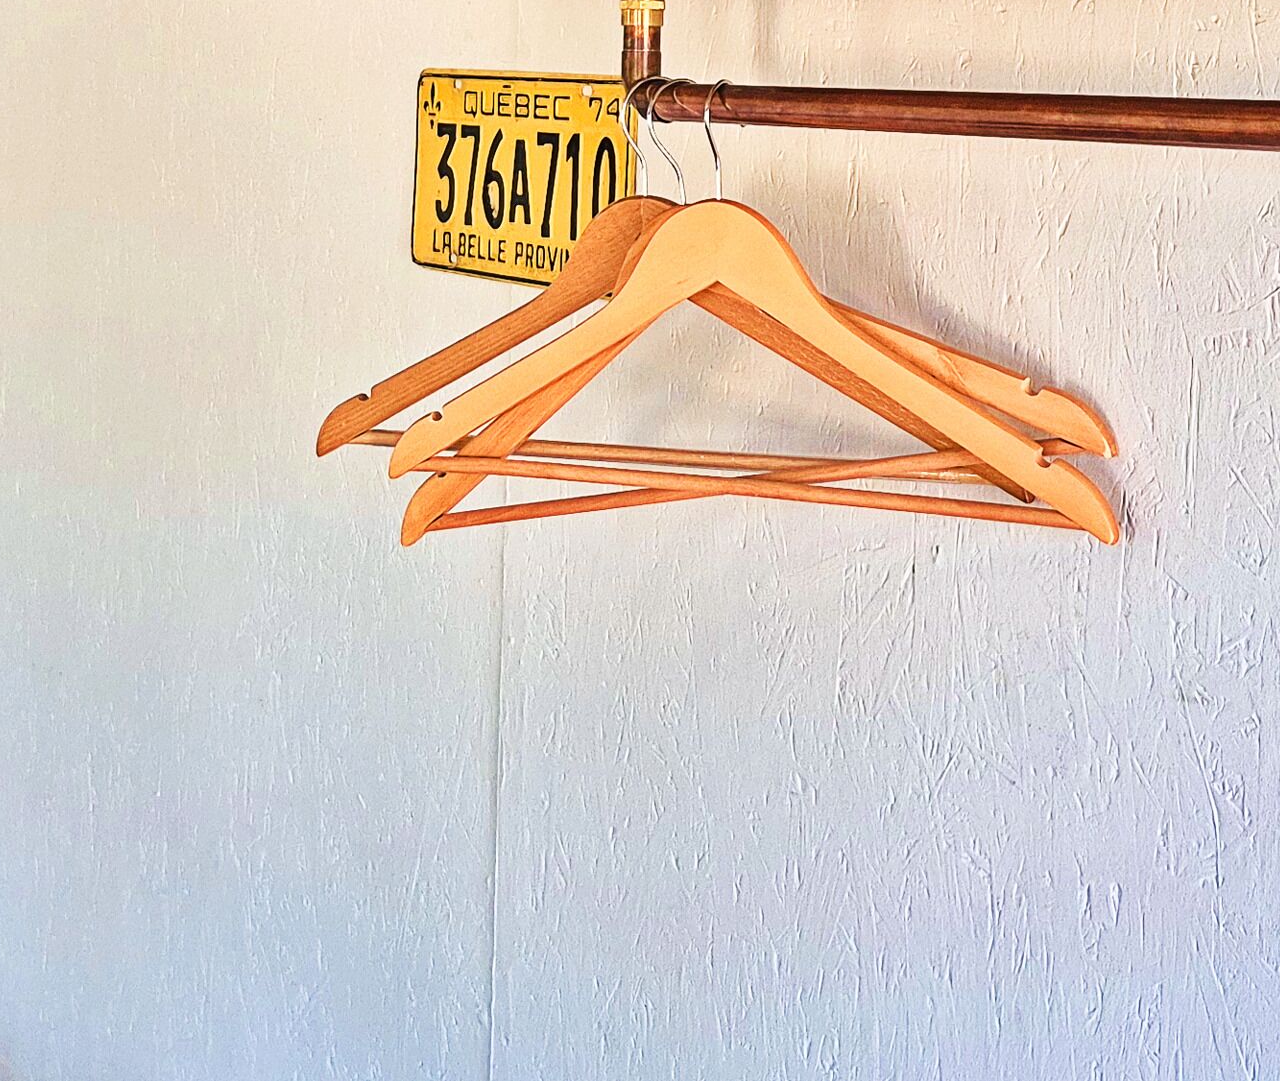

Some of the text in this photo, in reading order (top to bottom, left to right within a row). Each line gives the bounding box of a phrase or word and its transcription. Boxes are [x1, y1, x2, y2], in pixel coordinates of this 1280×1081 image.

[463, 84, 620, 124] QUÉBEC 74
[435, 122, 617, 242] 376A710
[432, 229, 452, 254] LA
[458, 232, 506, 263] BELLE
